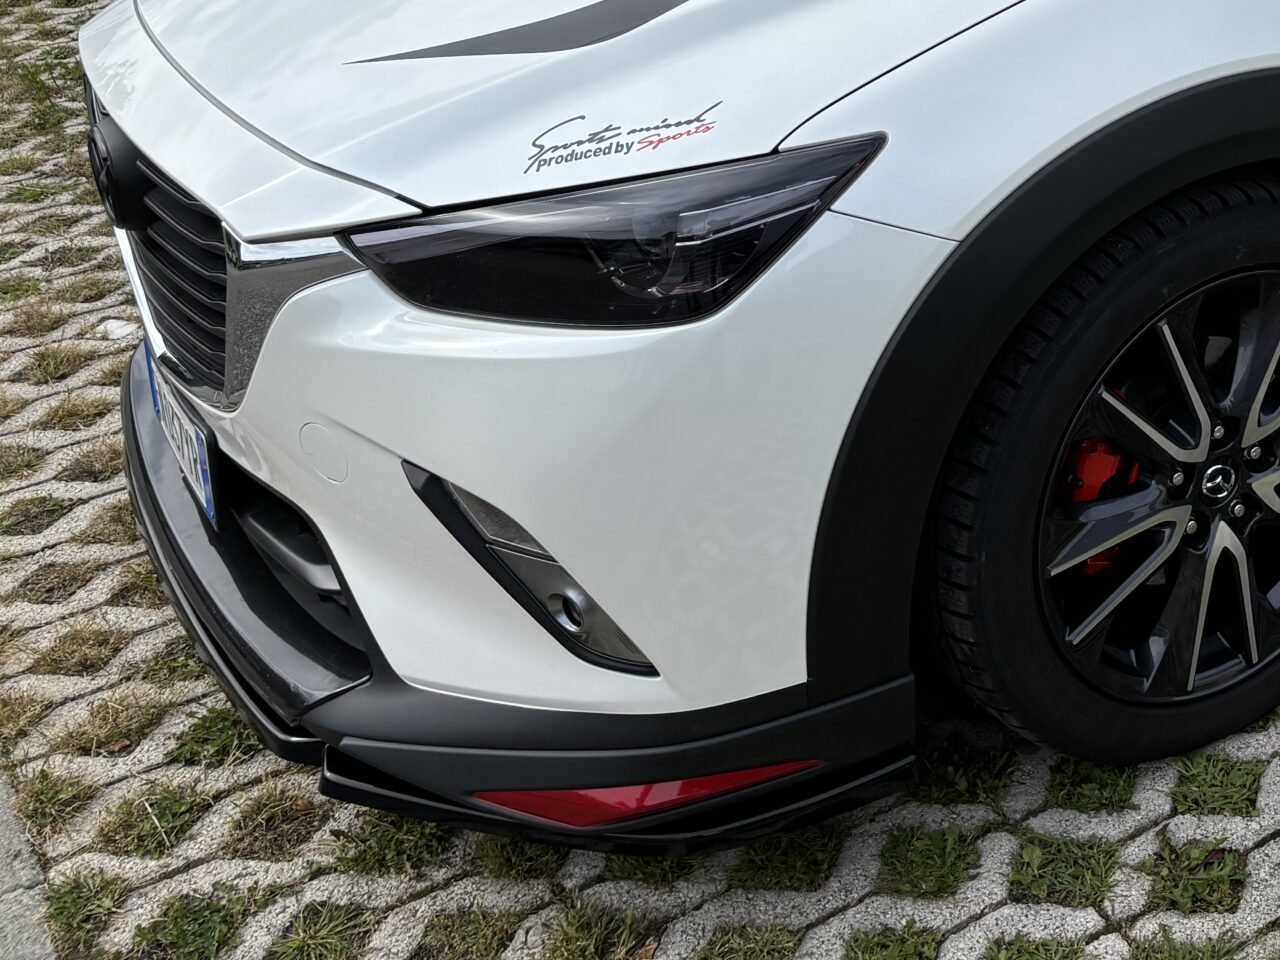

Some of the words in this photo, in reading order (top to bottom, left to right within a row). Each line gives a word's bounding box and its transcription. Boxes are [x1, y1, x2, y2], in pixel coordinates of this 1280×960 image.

[535, 142, 613, 173] produced
[613, 140, 636, 156] by
[636, 120, 718, 152] Sports
